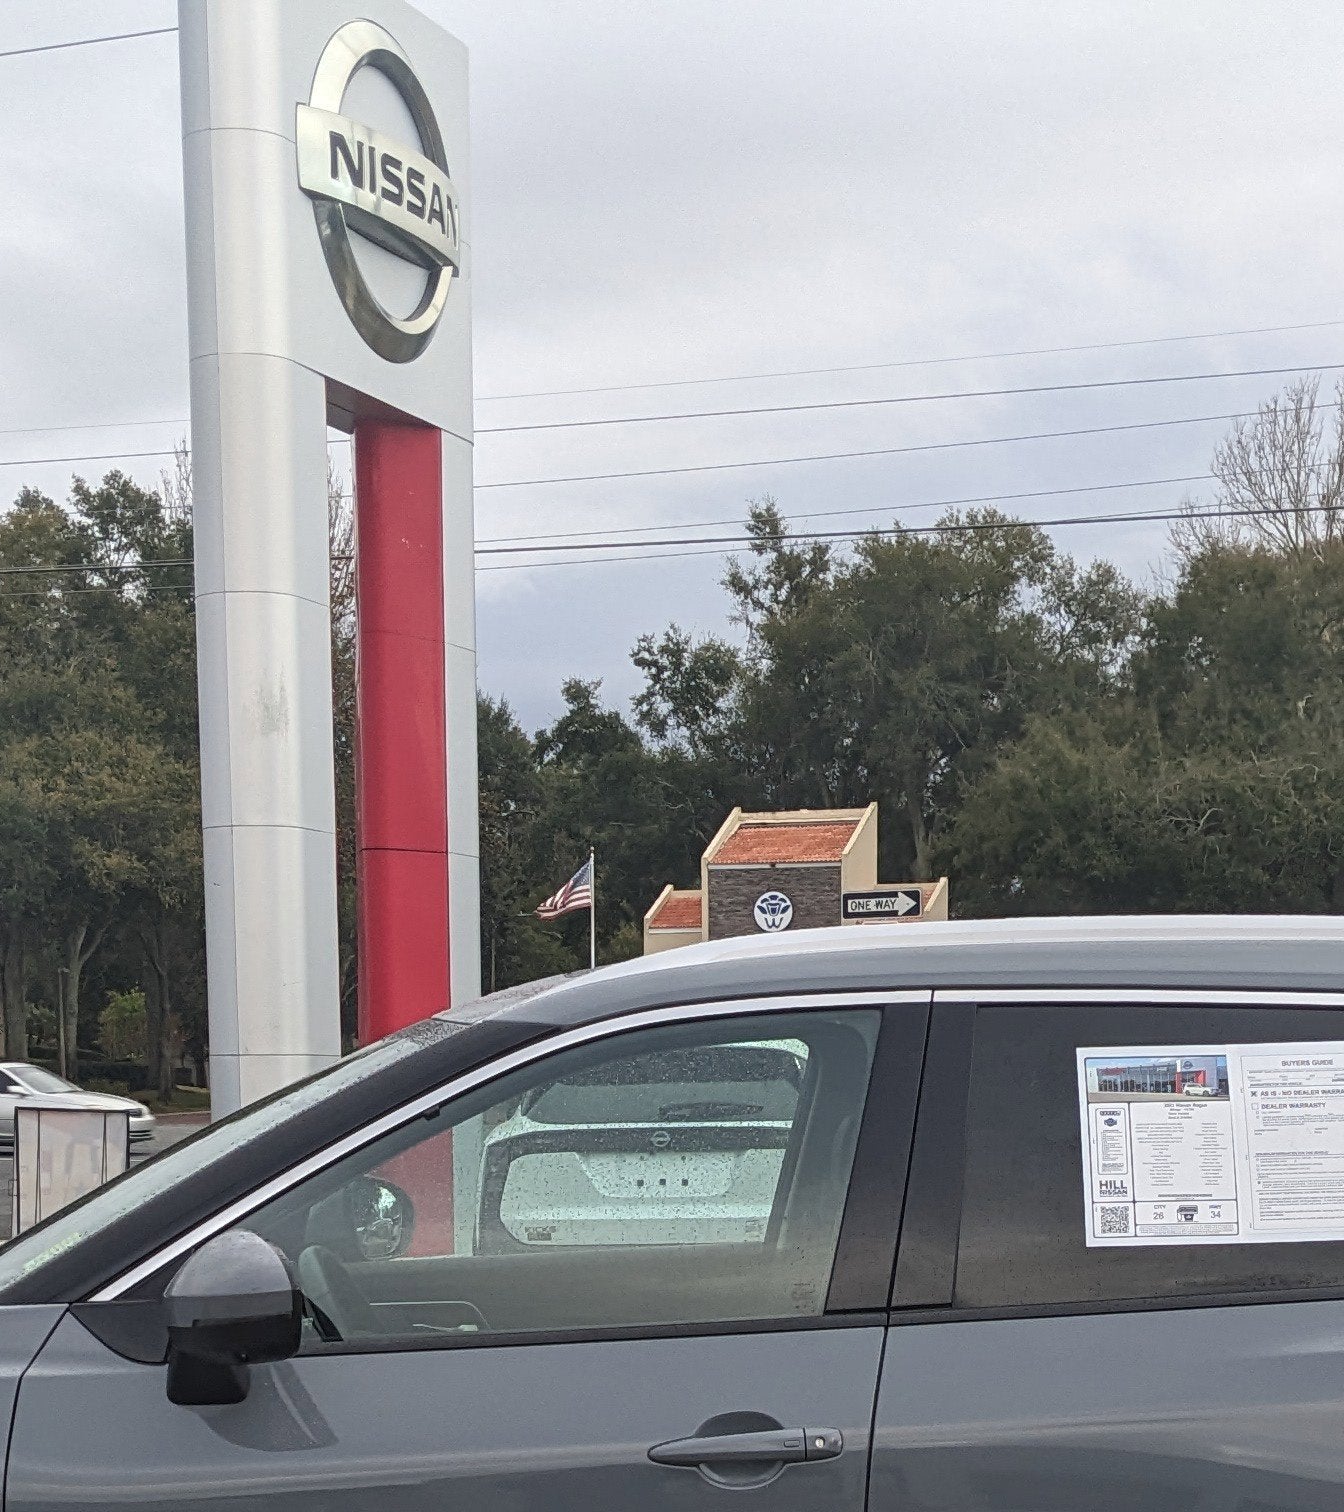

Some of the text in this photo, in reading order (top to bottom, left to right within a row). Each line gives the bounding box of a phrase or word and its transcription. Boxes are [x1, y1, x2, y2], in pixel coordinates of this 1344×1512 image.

[329, 130, 459, 248] NISSAN
[850, 899, 897, 911] ONE WAY
[1099, 1180, 1127, 1190] HILL
